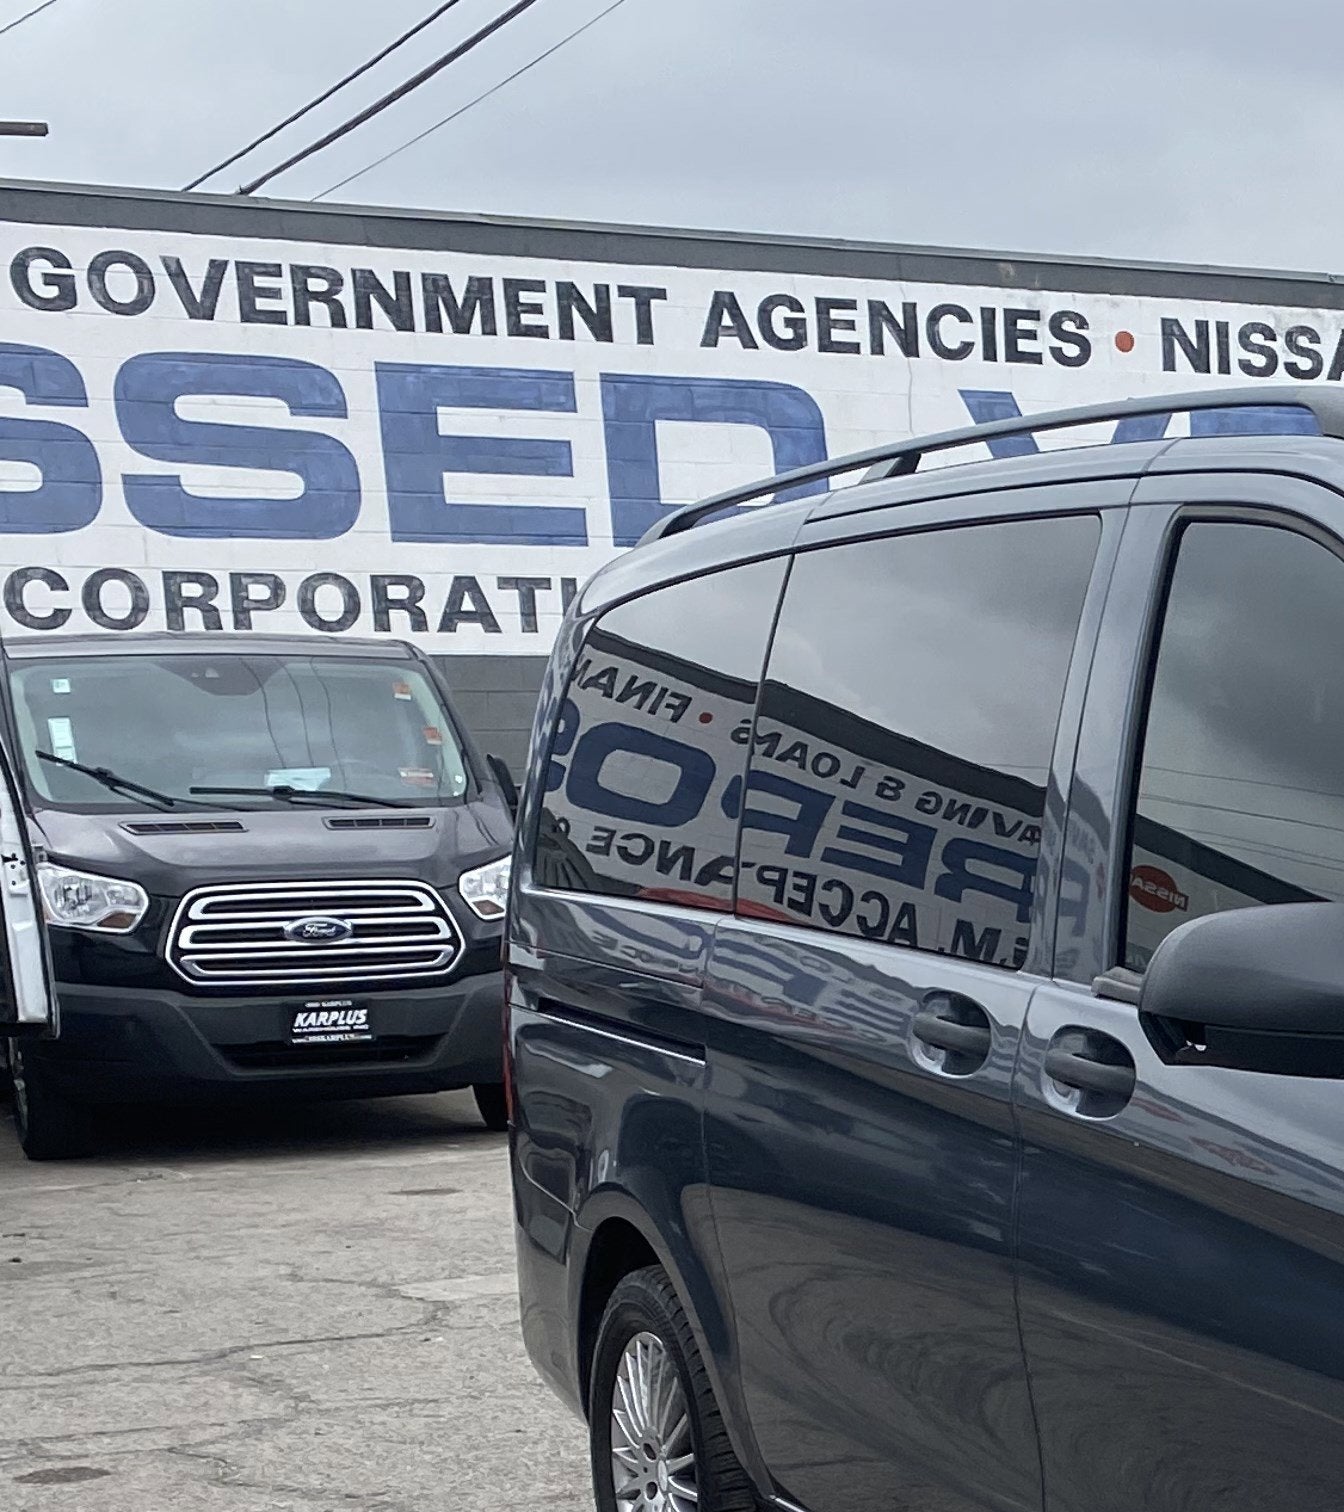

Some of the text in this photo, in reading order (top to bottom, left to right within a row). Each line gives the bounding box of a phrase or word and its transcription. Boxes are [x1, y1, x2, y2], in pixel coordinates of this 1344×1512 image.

[9, 246, 667, 346] GOVERNMENT
[700, 289, 1092, 367] AGENCIES
[294, 1009, 368, 1028] KARPLUS
